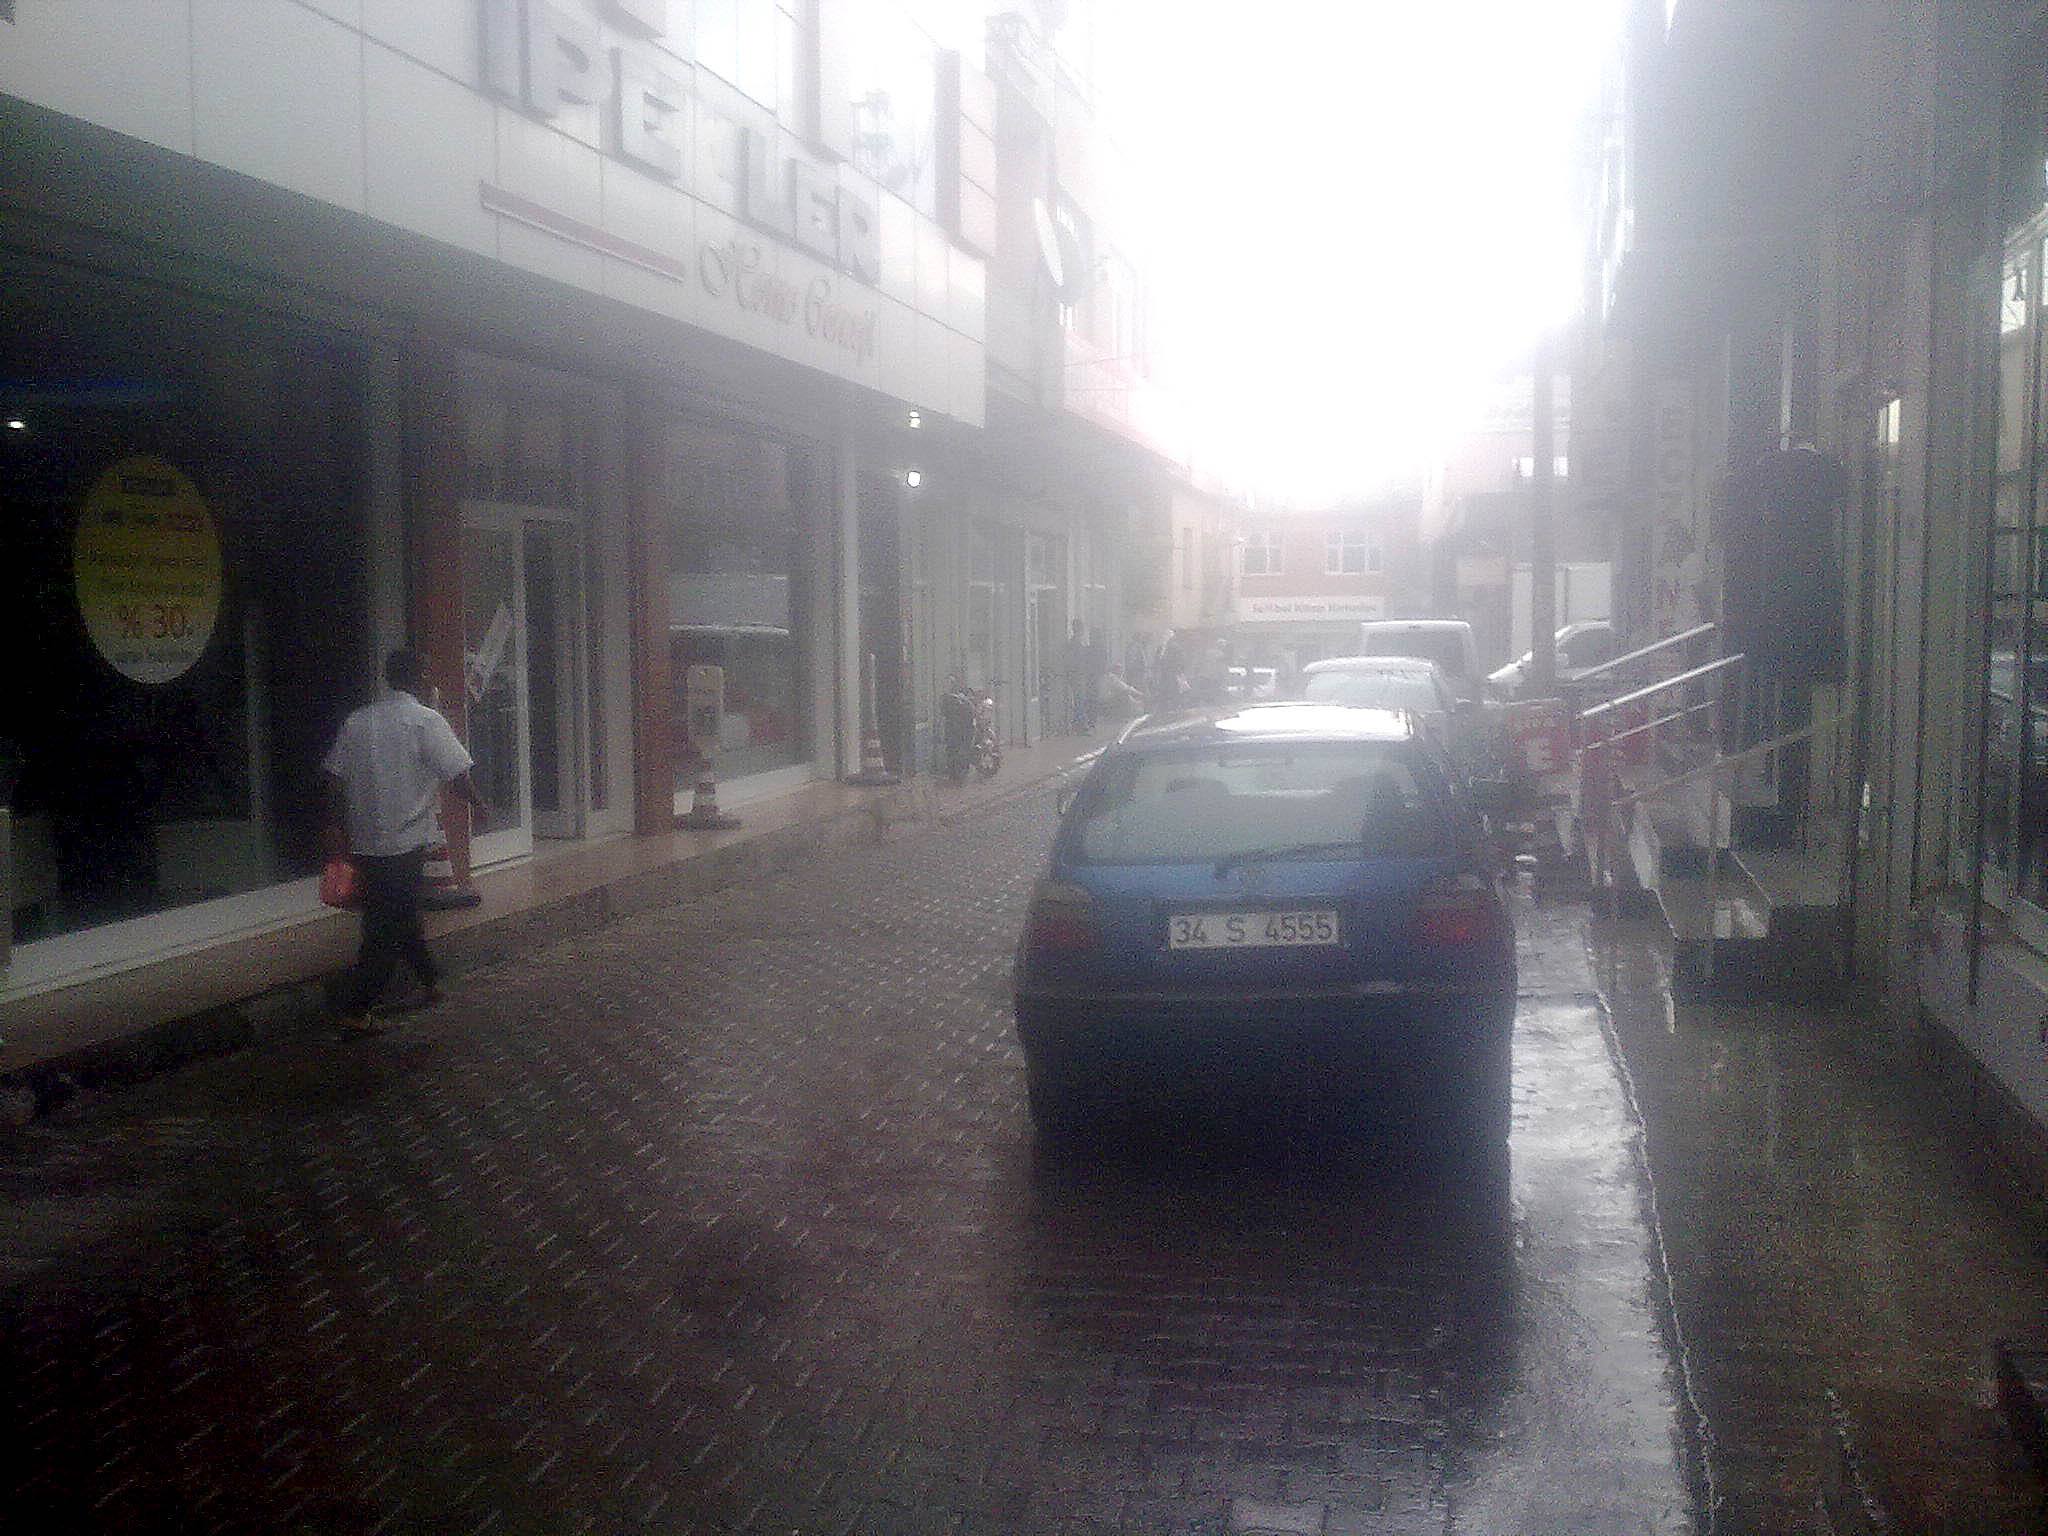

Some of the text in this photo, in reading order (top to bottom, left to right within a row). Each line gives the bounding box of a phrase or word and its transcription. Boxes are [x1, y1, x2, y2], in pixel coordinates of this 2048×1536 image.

[474, 0, 881, 286] IPELER
[1174, 912, 1333, 944] 34 S 4555
